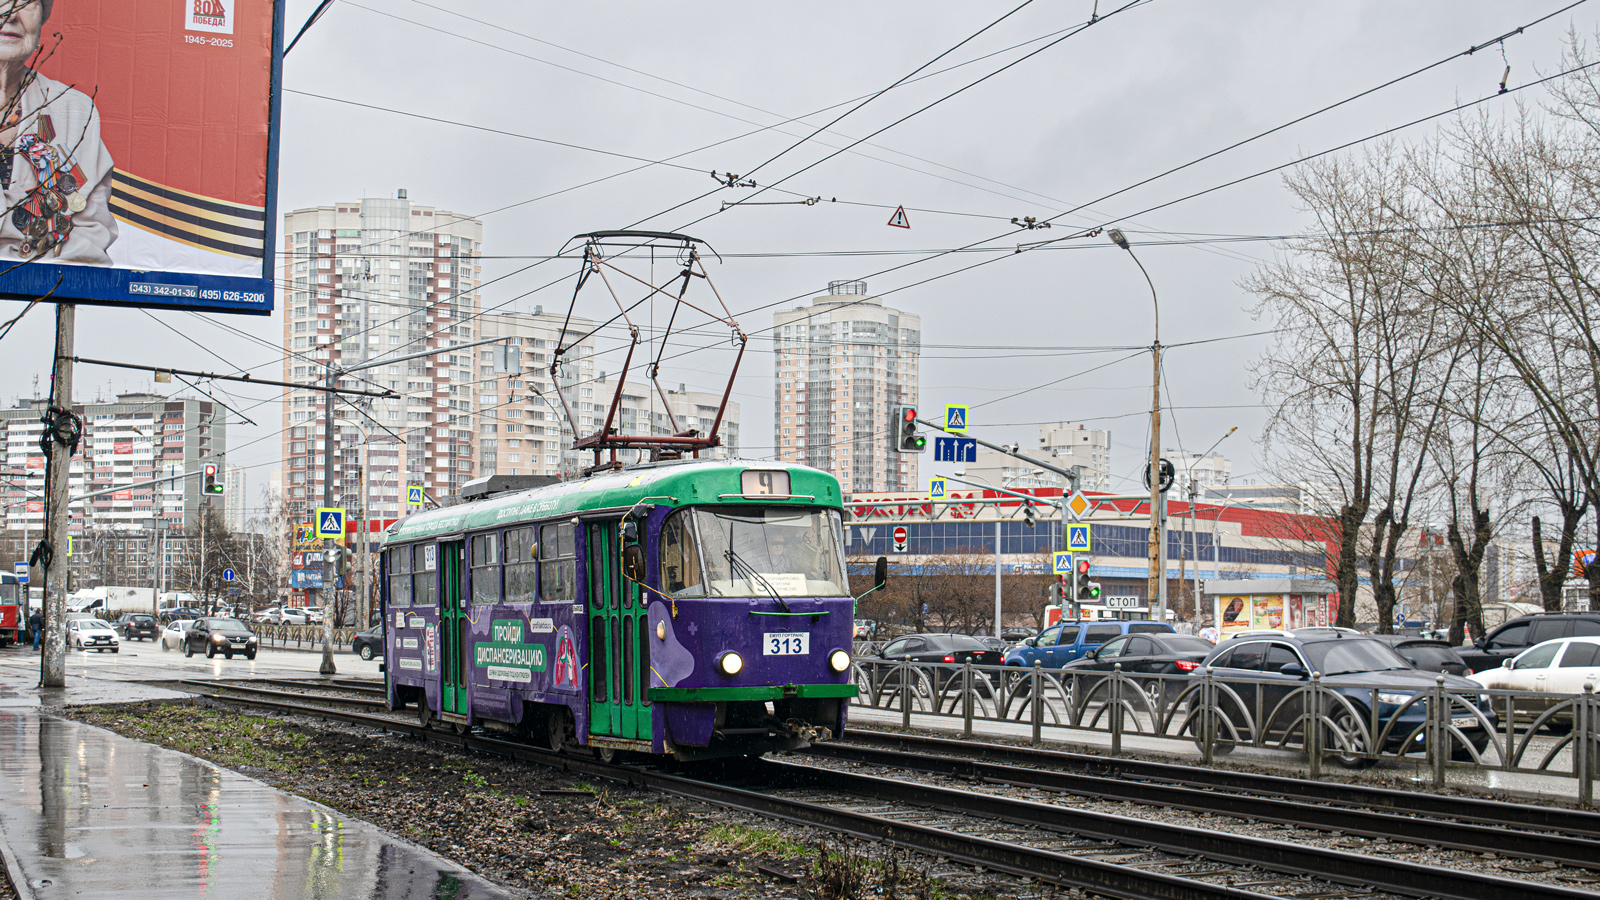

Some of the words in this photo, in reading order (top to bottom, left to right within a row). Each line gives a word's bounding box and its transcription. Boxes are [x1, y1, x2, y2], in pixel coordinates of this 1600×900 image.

[192, 15, 226, 27] ПОБЕДА!
[184, 35, 234, 48] 1945–2025
[129, 283, 151, 293] (343)
[154, 286, 196, 297] 342-01-30
[199, 289, 221, 300] (495)
[223, 291, 265, 303] 626-5200
[759, 472, 773, 495] 9
[425, 546, 435, 562] 313
[1109, 597, 1136, 607] СТОП
[494, 621, 521, 644] ПРОЙДИ
[770, 638, 802, 654] 313
[476, 647, 543, 668] ДИСПАНСЕРИЗАЦИЮ
